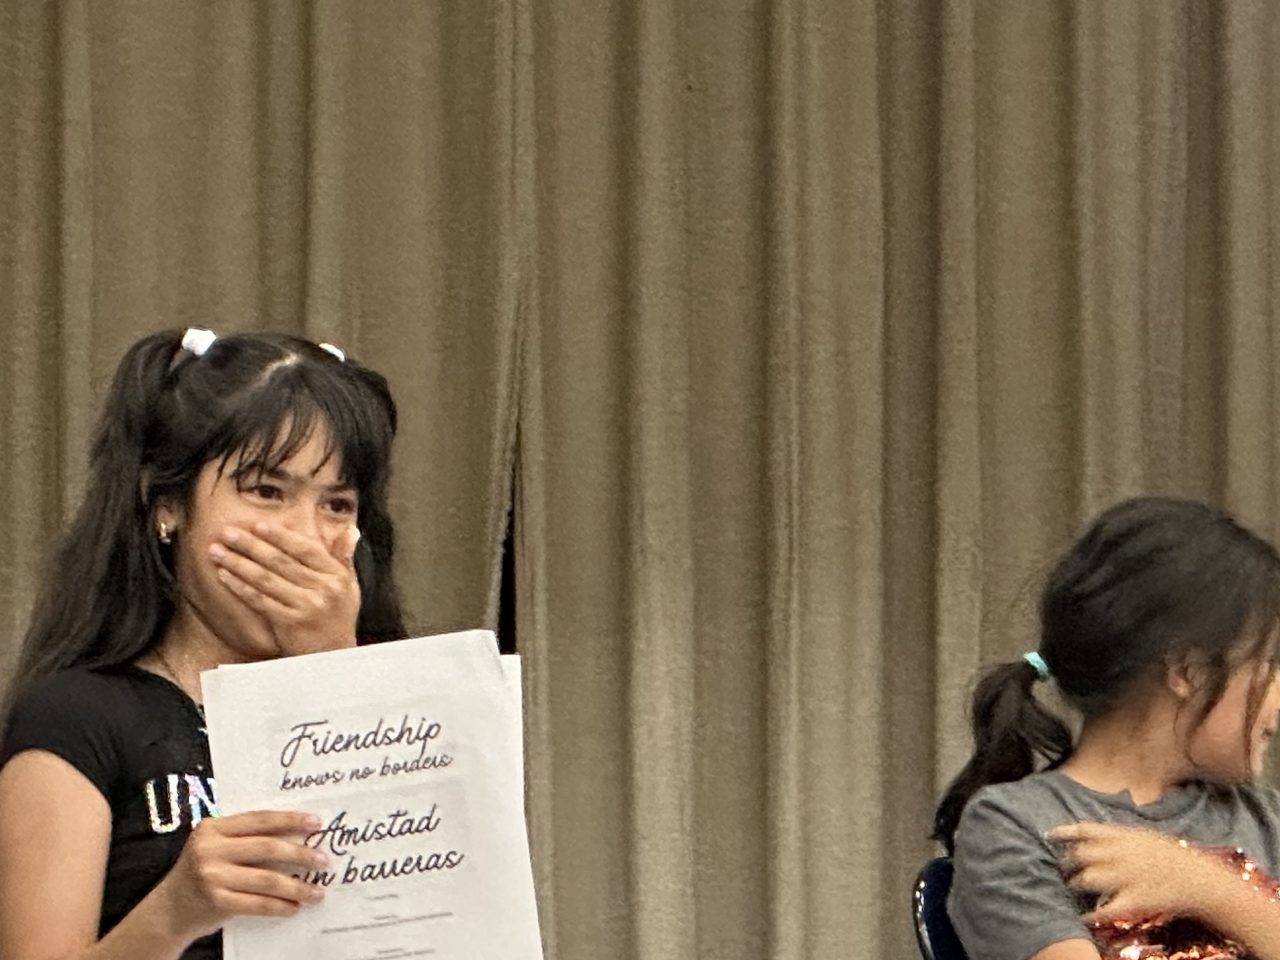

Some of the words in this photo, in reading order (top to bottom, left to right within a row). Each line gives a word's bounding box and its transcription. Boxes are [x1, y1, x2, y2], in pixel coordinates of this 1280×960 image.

[280, 715, 442, 767] Friendship
[280, 770, 344, 791] knows
[349, 766, 375, 781] no
[380, 753, 454, 775] borders
[304, 804, 442, 856] Amistad
[291, 871, 336, 887] in
[342, 849, 465, 886] barreras
